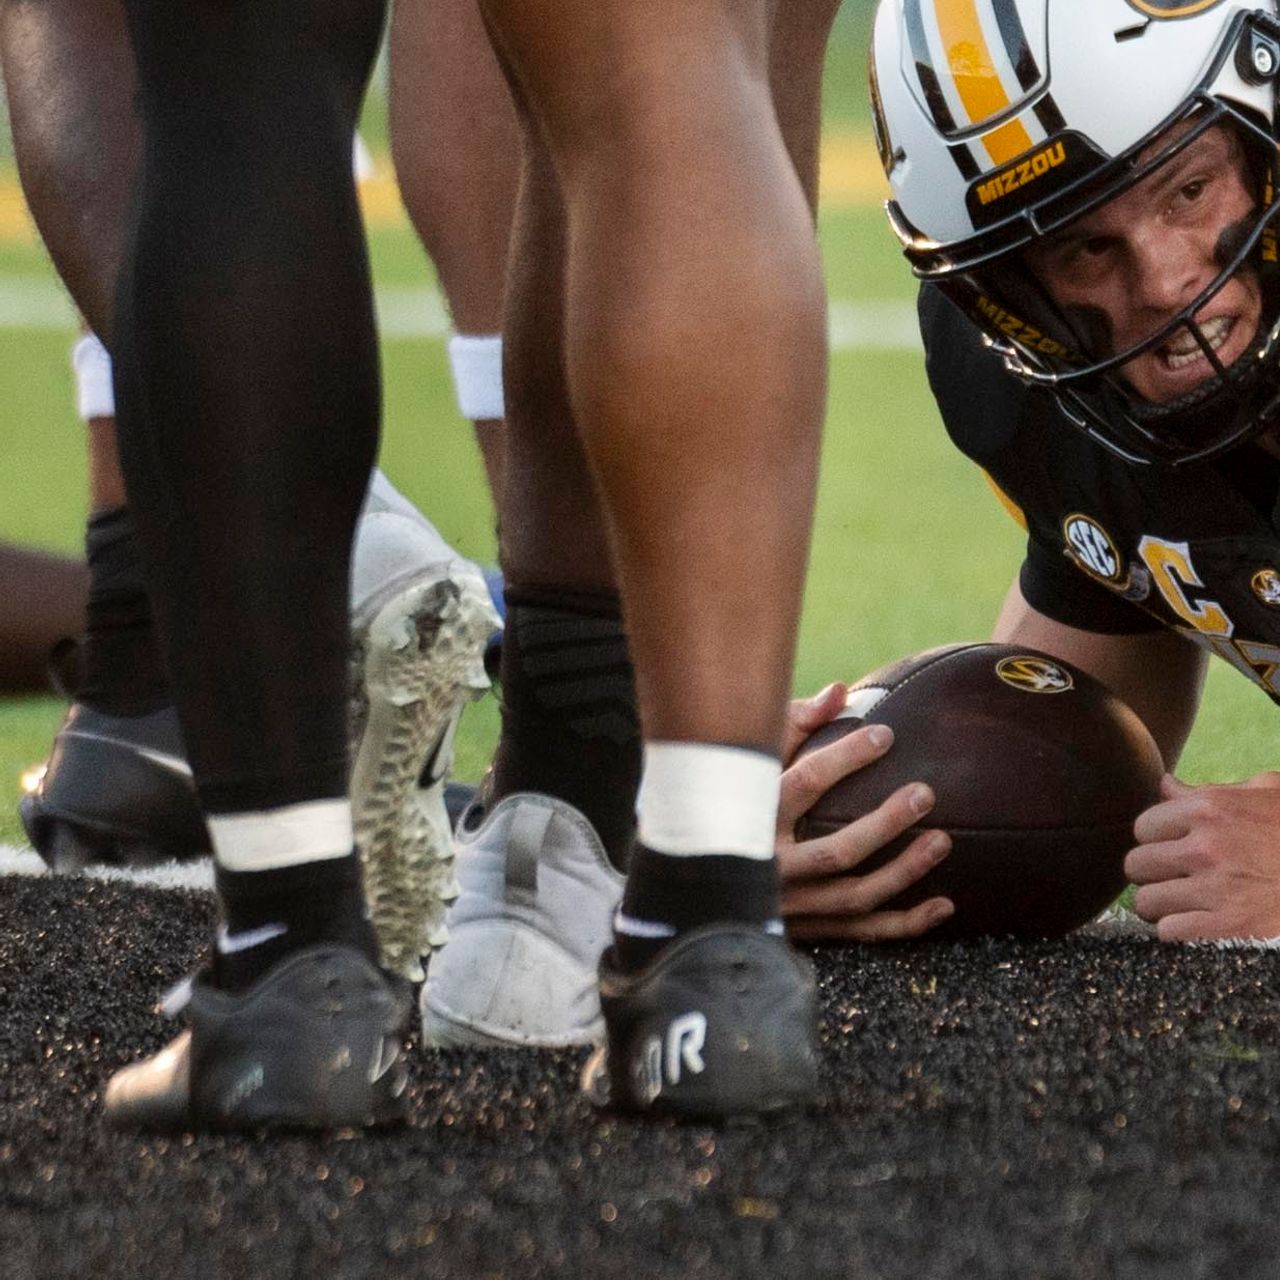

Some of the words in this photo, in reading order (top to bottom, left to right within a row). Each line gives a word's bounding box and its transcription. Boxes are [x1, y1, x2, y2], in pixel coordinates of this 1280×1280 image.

[975, 141, 1067, 206] MIZZOU
[1065, 519, 1119, 578] SEC
[1138, 534, 1234, 639] C
